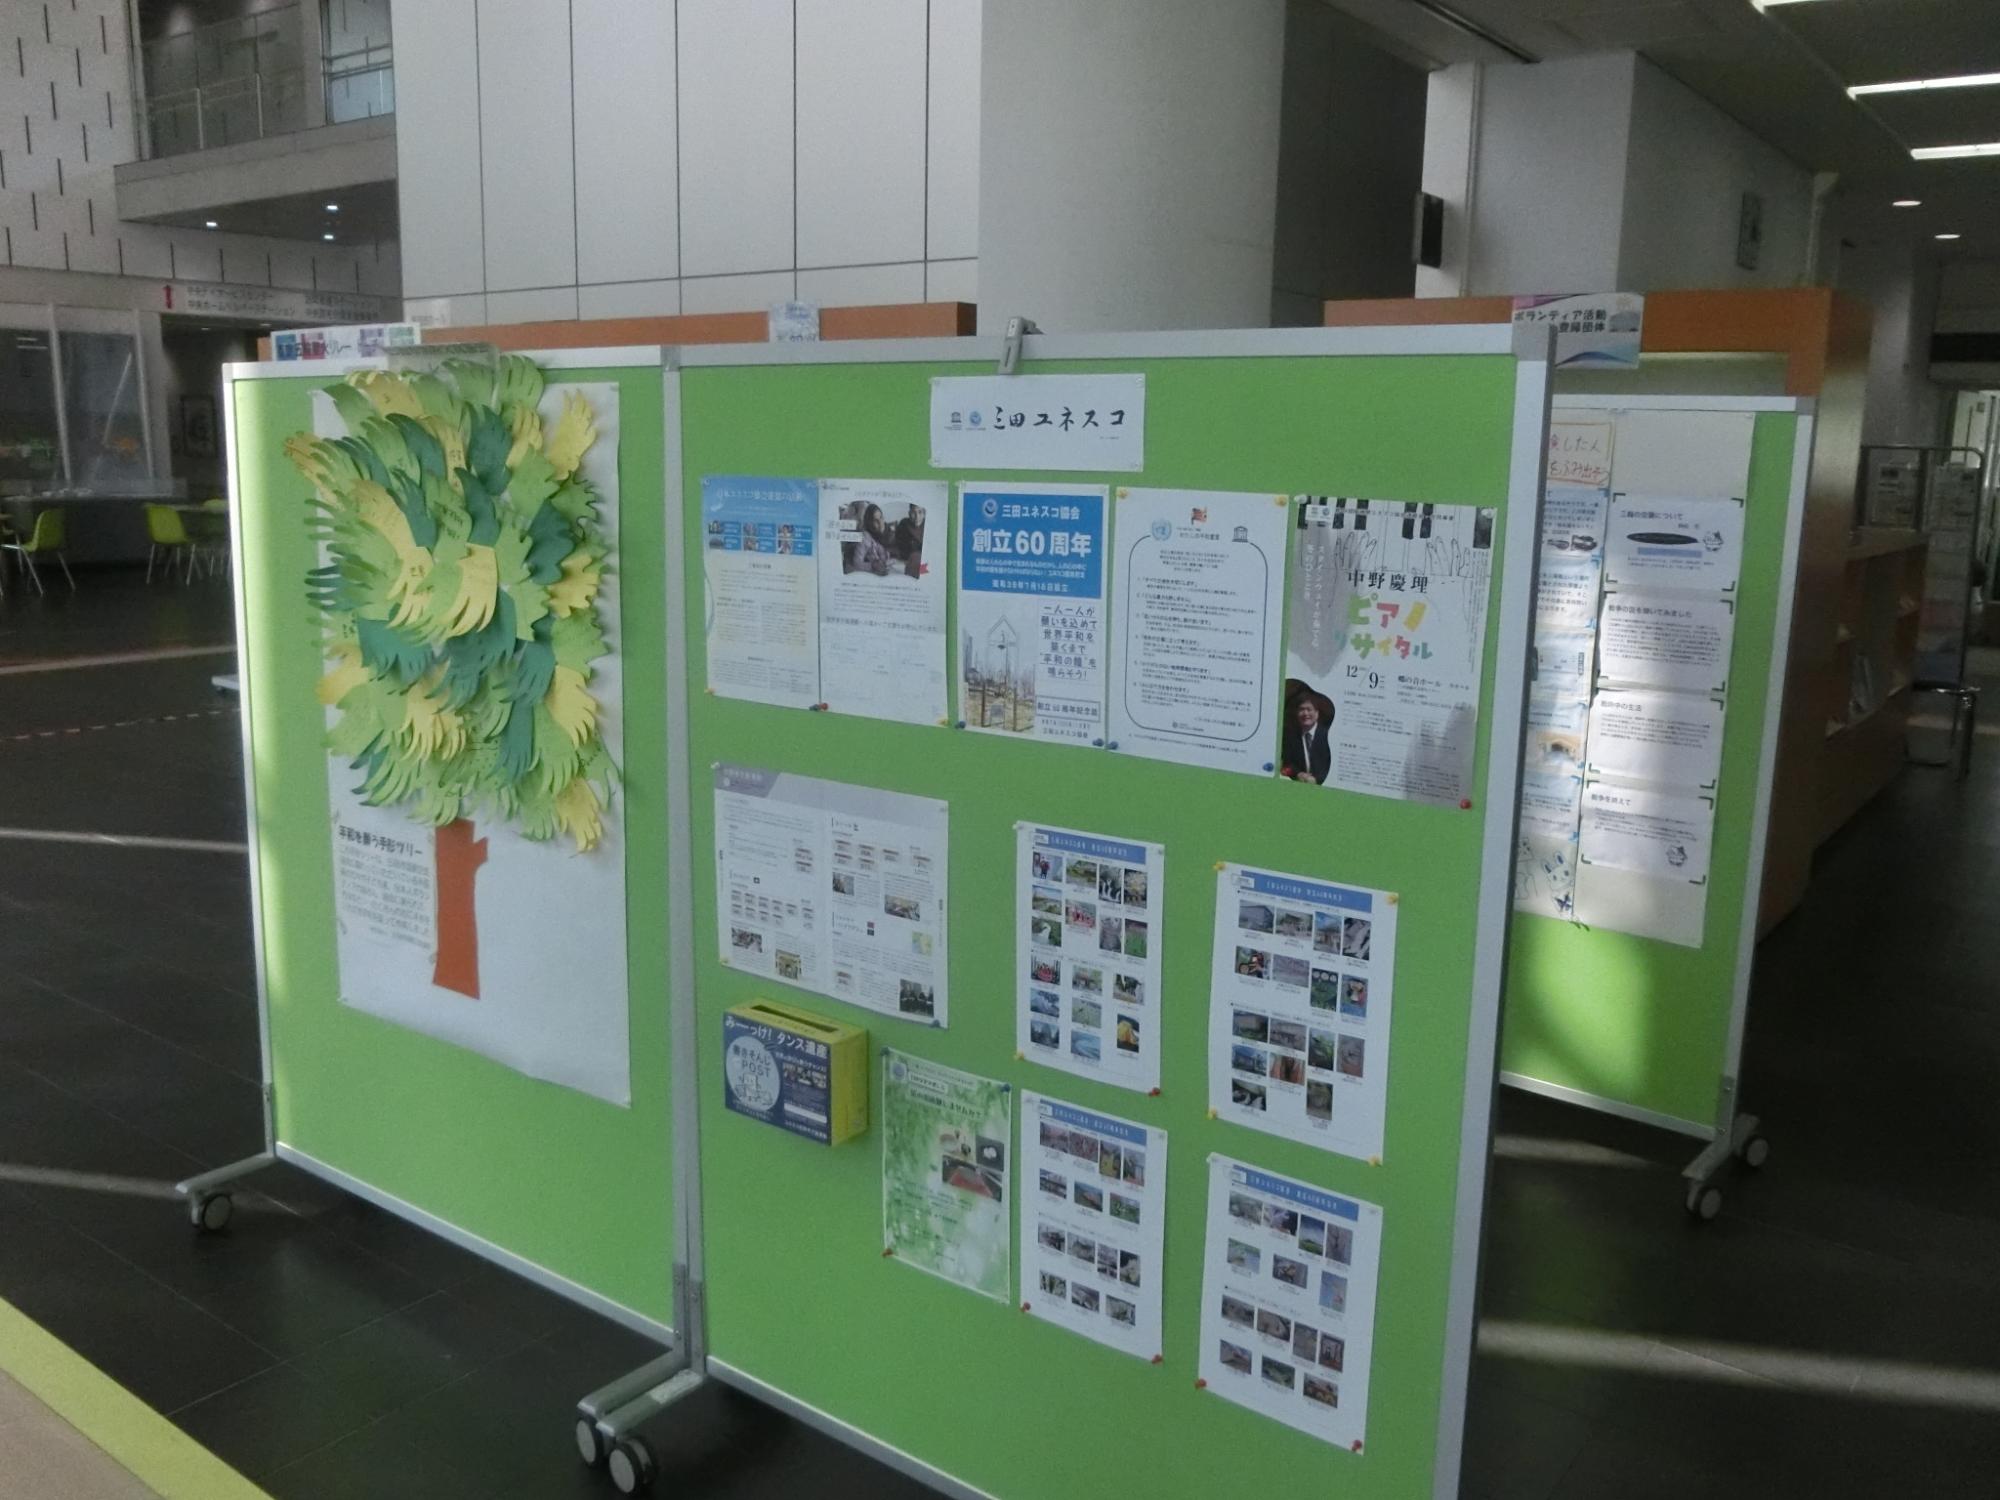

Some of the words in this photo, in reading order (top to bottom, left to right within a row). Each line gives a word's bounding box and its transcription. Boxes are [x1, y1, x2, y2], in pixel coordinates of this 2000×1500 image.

[1514, 309, 1607, 321] ボランティア活動
[994, 406, 1125, 431] 三田ユネスコ
[1001, 504, 1080, 520] 三田ユネスコ協会
[972, 528, 1092, 557] 創立60周年
[1349, 569, 1428, 594] 中野慶理
[1044, 605, 1095, 617] 一人一人が
[1349, 592, 1427, 632] ピアノ
[1043, 628, 1094, 642] 世界平和を
[1346, 664, 1359, 678] 12
[1369, 672, 1379, 689] 9
[742, 1060, 771, 1079] POST
